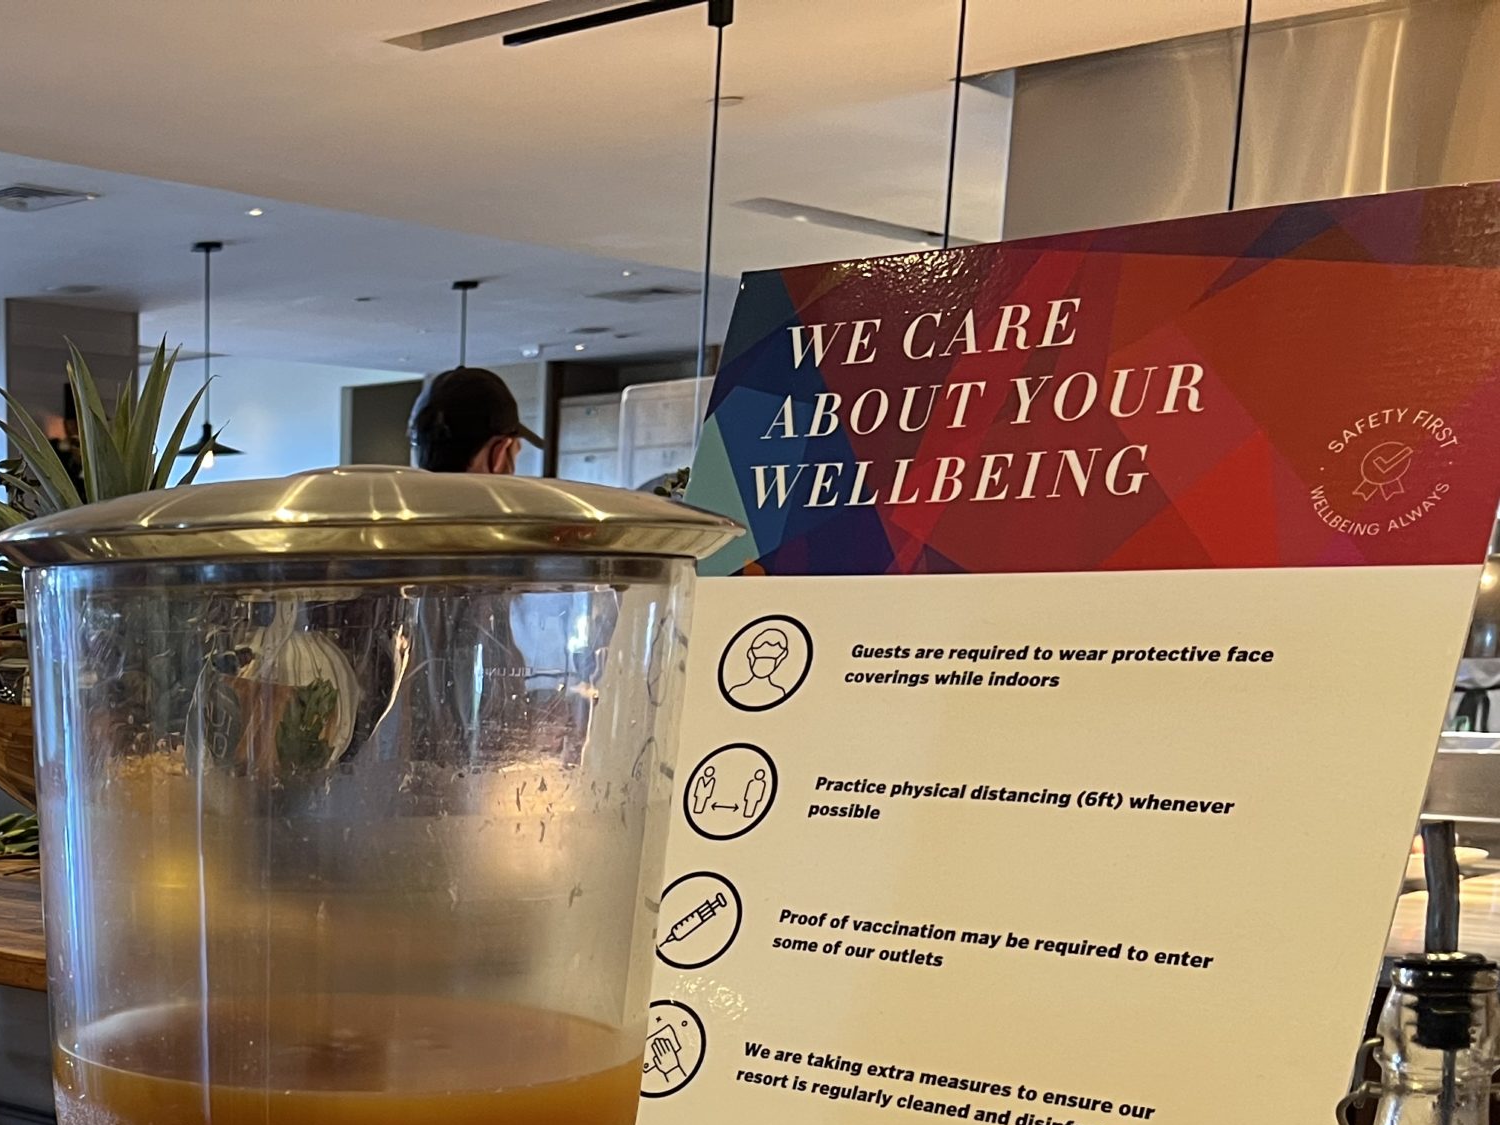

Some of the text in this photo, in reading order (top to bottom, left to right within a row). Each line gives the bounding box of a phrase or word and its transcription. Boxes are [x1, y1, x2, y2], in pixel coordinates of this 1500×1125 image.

[786, 297, 1082, 370] WE CARE
[759, 362, 1206, 440] ABOUT YOUR
[1327, 407, 1459, 454] SAFETY FIRST
[749, 443, 1151, 511] WELLBEING
[1310, 482, 1450, 536] WELLBEING ALWAYS
[844, 669, 1060, 688] coverings while indoors
[851, 644, 1275, 664] Guests are required to wear protective face
[807, 803, 881, 820] possible
[815, 776, 1236, 815] Practice physical distancing (6ft) whenever
[771, 935, 944, 968] some of our outlets
[778, 908, 1215, 969] Proof of vaccination may be required to enter
[735, 1068, 790, 1090] resort
[791, 1075, 807, 1092] is
[811, 1082, 894, 1109] regularly
[896, 1094, 972, 1120] cleaned
[744, 1041, 1156, 1120] We are taking extra measures to ensure our
